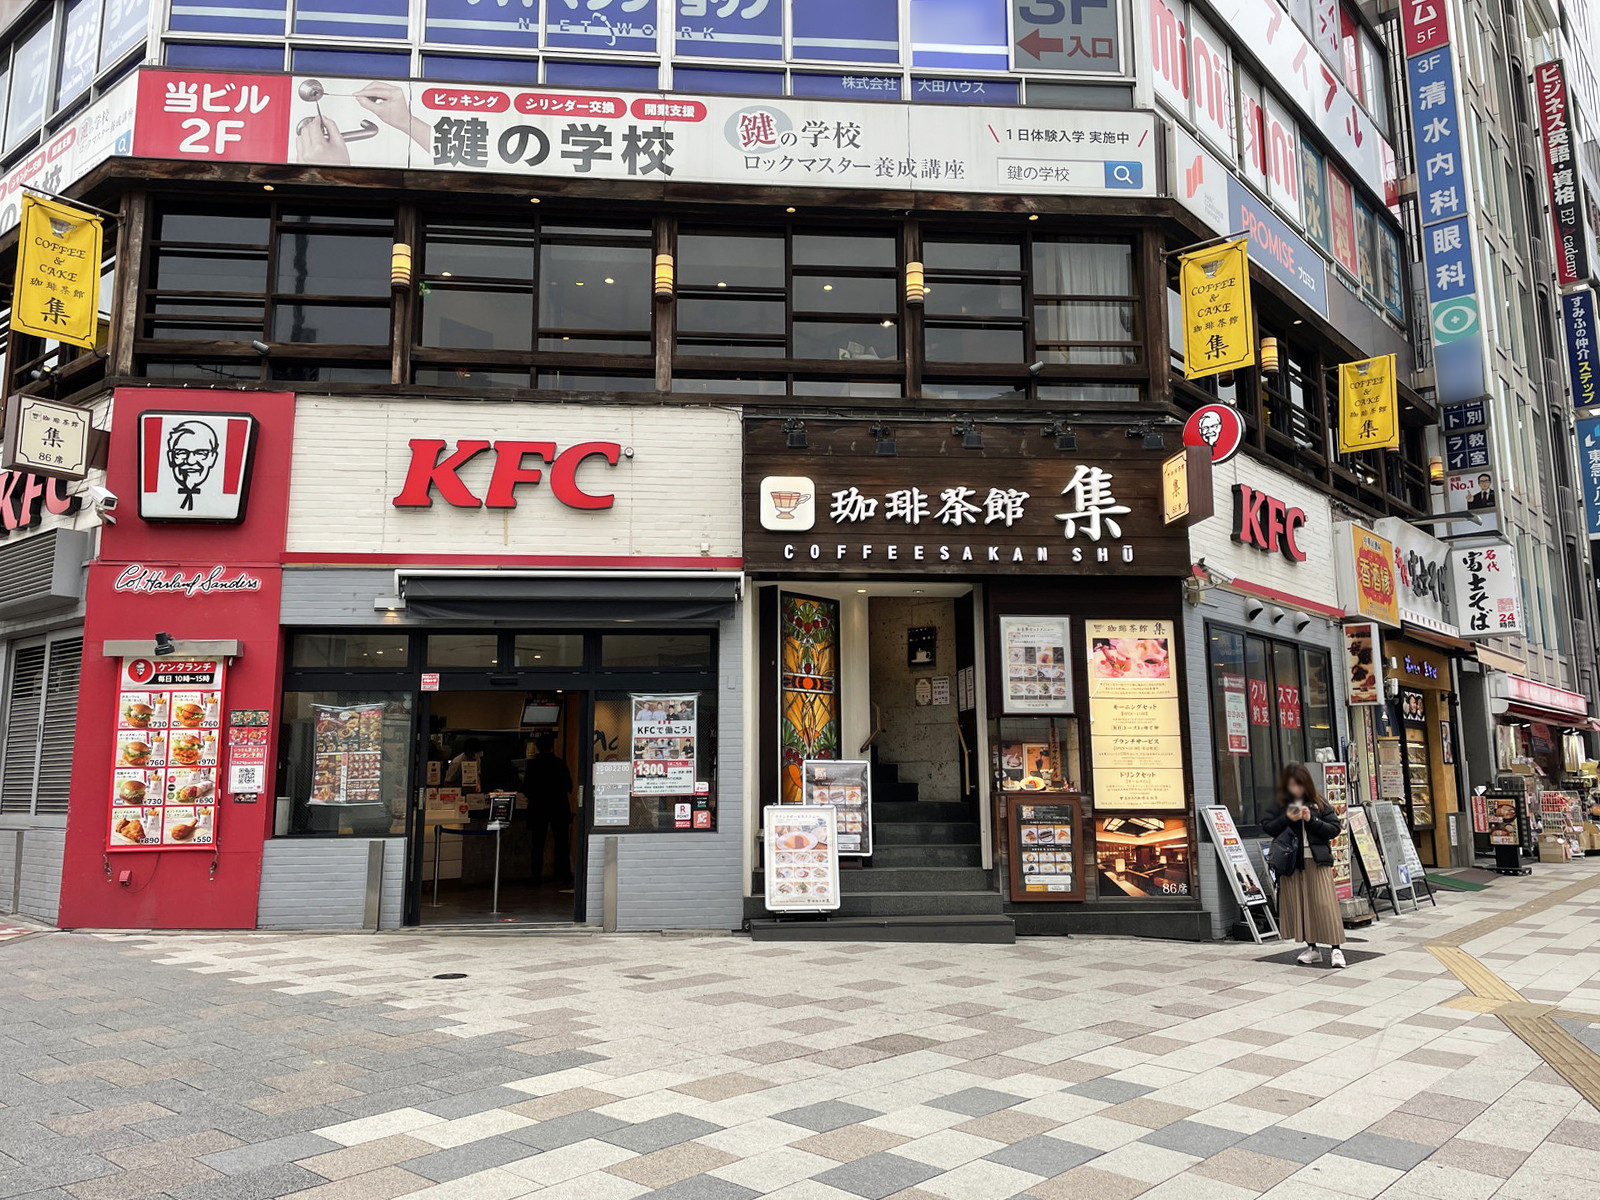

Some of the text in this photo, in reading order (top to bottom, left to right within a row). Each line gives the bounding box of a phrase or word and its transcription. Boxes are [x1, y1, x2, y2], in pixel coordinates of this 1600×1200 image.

[1417, 27, 1437, 44] 5F
[1066, 35, 1114, 59] 入口
[1417, 54, 1441, 74] 3F
[842, 75, 986, 96] 株式会社 大田ハウス
[162, 80, 271, 115] 当ビル
[433, 94, 499, 109] ピッキング
[525, 98, 616, 116] シリンダー交換
[644, 103, 696, 119] 開業支援
[179, 118, 246, 155] 2F
[739, 111, 863, 151] 鍵の学校
[1006, 127, 1130, 146] 1日体験入学 実施中
[1541, 63, 1576, 207] ビジネス英語・資格
[433, 116, 676, 177] 鍵の学校
[1418, 80, 1459, 217] 清水内科
[744, 154, 966, 182] ロックマスター養成講座
[1007, 165, 1071, 183] 鍵の学校
[1302, 143, 1324, 240] 清水
[1330, 171, 1352, 267] 眼科
[34, 236, 87, 260] COFFEE
[1241, 204, 1296, 275] PROMISE
[53, 256, 66, 266] &
[1432, 224, 1466, 291] 眼科
[39, 264, 78, 283] CAKE
[1298, 266, 1316, 292] プロミス
[30, 277, 86, 299] 珈琲茶館
[1191, 277, 1237, 297] COFFEE
[1208, 293, 1220, 303] &
[40, 296, 71, 326] 集
[1197, 302, 1232, 319] CAKE
[1193, 315, 1239, 333] 珈琲茶館
[1204, 334, 1230, 360] 集
[1349, 376, 1386, 390] COFFEE
[1363, 388, 1372, 396] &
[1354, 396, 1381, 408] CAKE
[41, 427, 65, 448] 集
[1358, 419, 1379, 439] 集
[393, 438, 622, 511] KFC
[1450, 480, 1474, 492] No.1
[829, 463, 1132, 543] 珈琲茶館 集
[1234, 483, 1307, 563] KFC
[199, 564, 260, 591] Sanders
[1462, 550, 1493, 632] 富士そば
[1498, 612, 1516, 622] 24
[1152, 621, 1166, 636] 集
[158, 662, 212, 673] ケンタランチ
[1161, 882, 1189, 895] 86席
